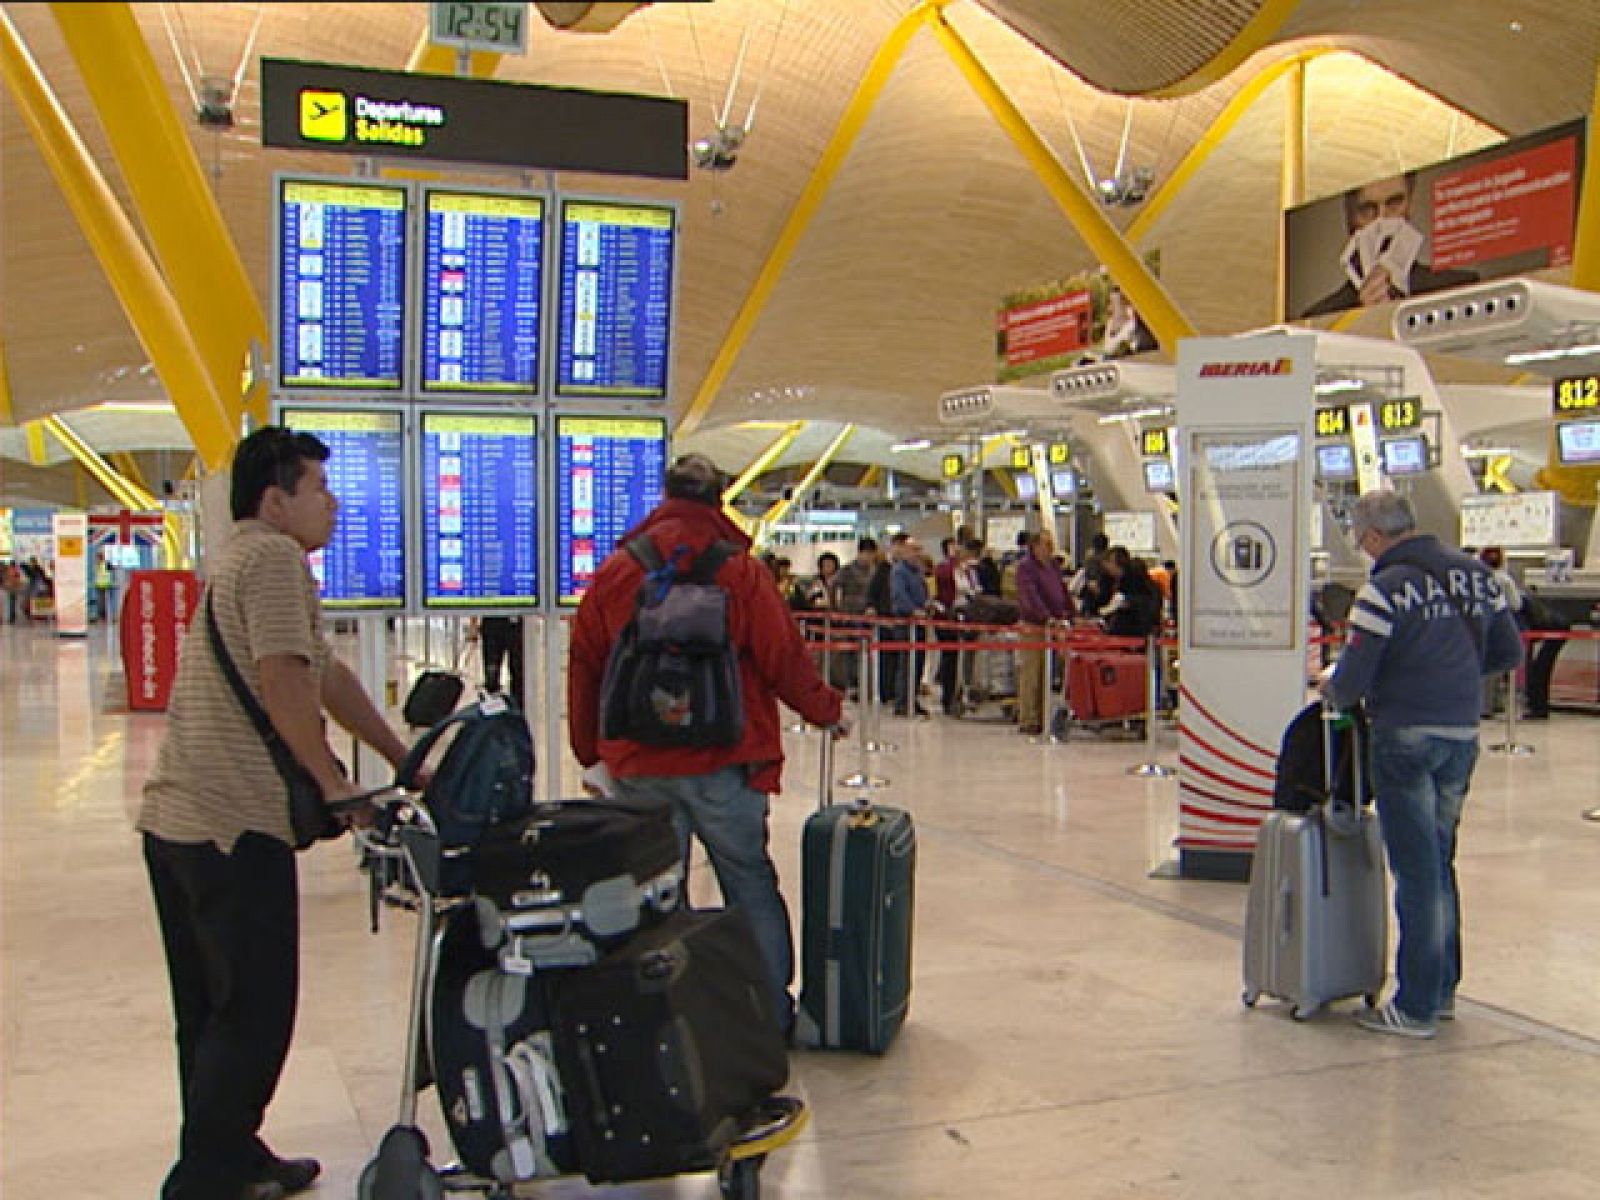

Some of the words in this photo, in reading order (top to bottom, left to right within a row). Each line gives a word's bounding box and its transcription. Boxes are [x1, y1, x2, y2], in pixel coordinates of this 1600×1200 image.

[449, 4, 521, 42] 12:54
[355, 96, 443, 126] Departures
[356, 119, 424, 146] Salidas
[1199, 361, 1273, 377] IBERIA
[1559, 376, 1598, 408] 812
[1382, 402, 1414, 428] 813
